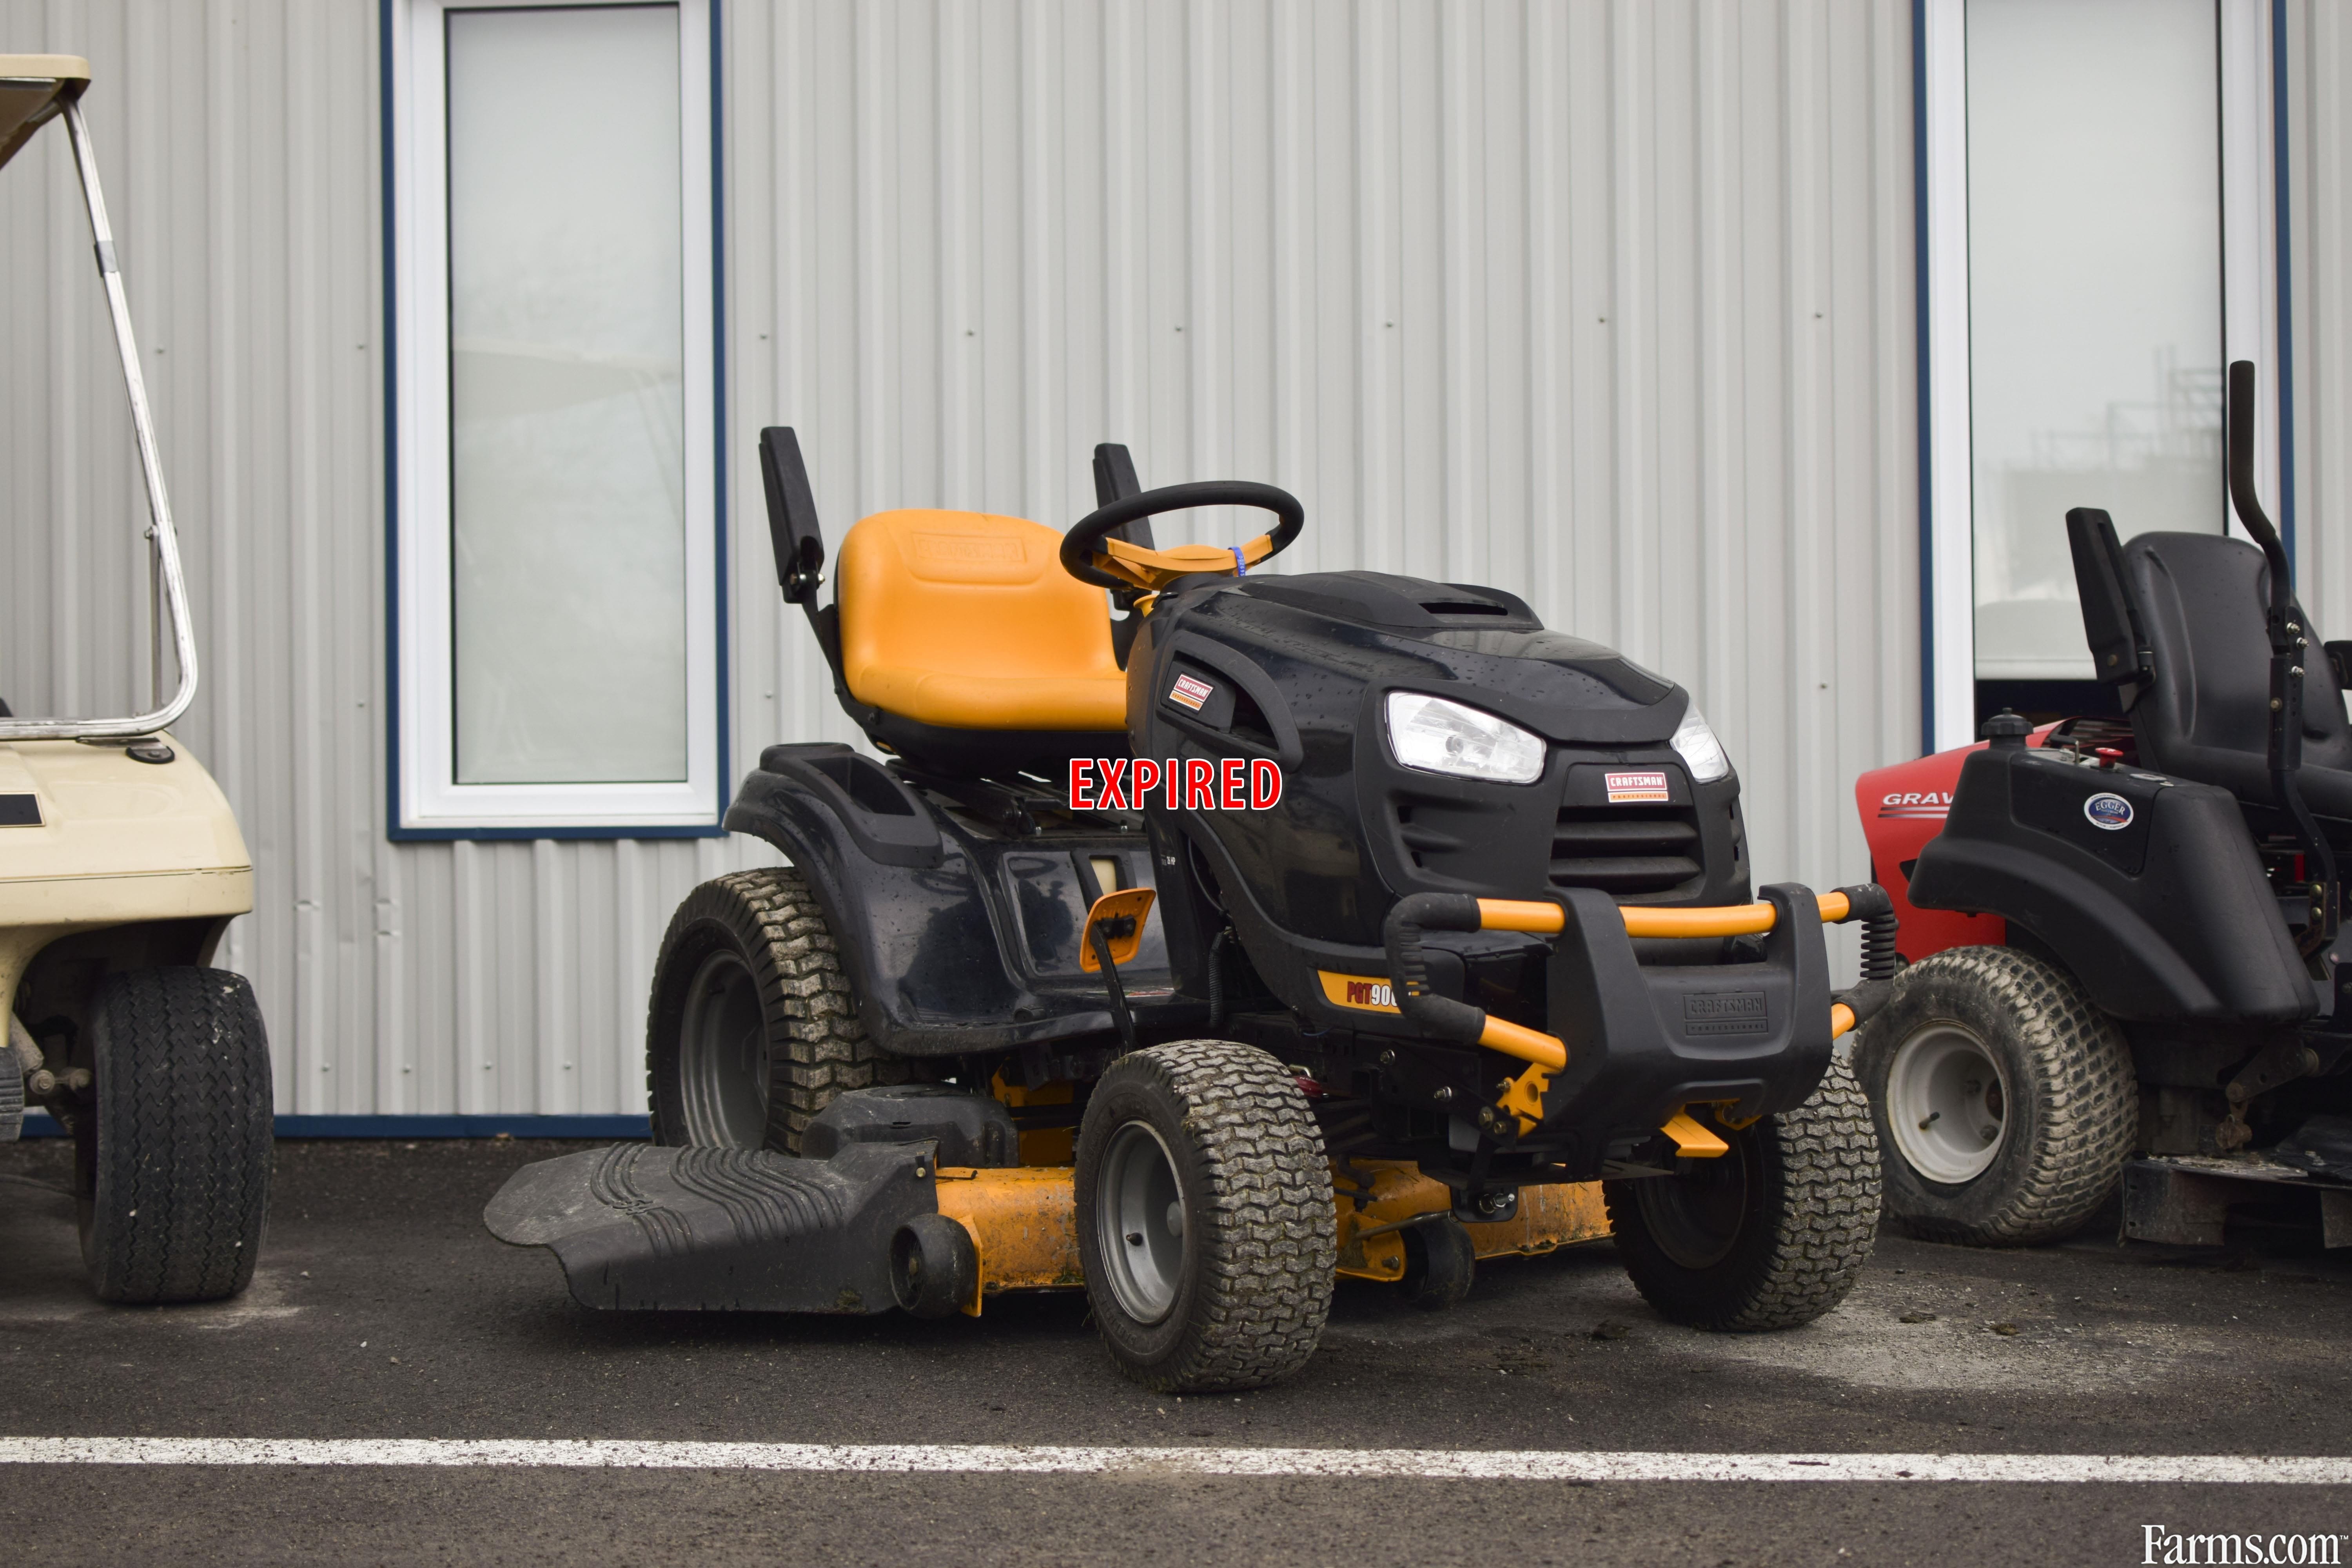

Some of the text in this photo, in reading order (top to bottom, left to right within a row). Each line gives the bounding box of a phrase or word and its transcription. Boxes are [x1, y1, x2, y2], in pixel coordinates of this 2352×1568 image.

[1178, 679, 1208, 697] CRAFTSMAN
[1610, 776, 1663, 787] CRAFTSMAN
[2094, 801, 2125, 816] EGGER
[1171, 857, 1176, 866] HP
[1690, 998, 1762, 1014] CRAFTSMAN
